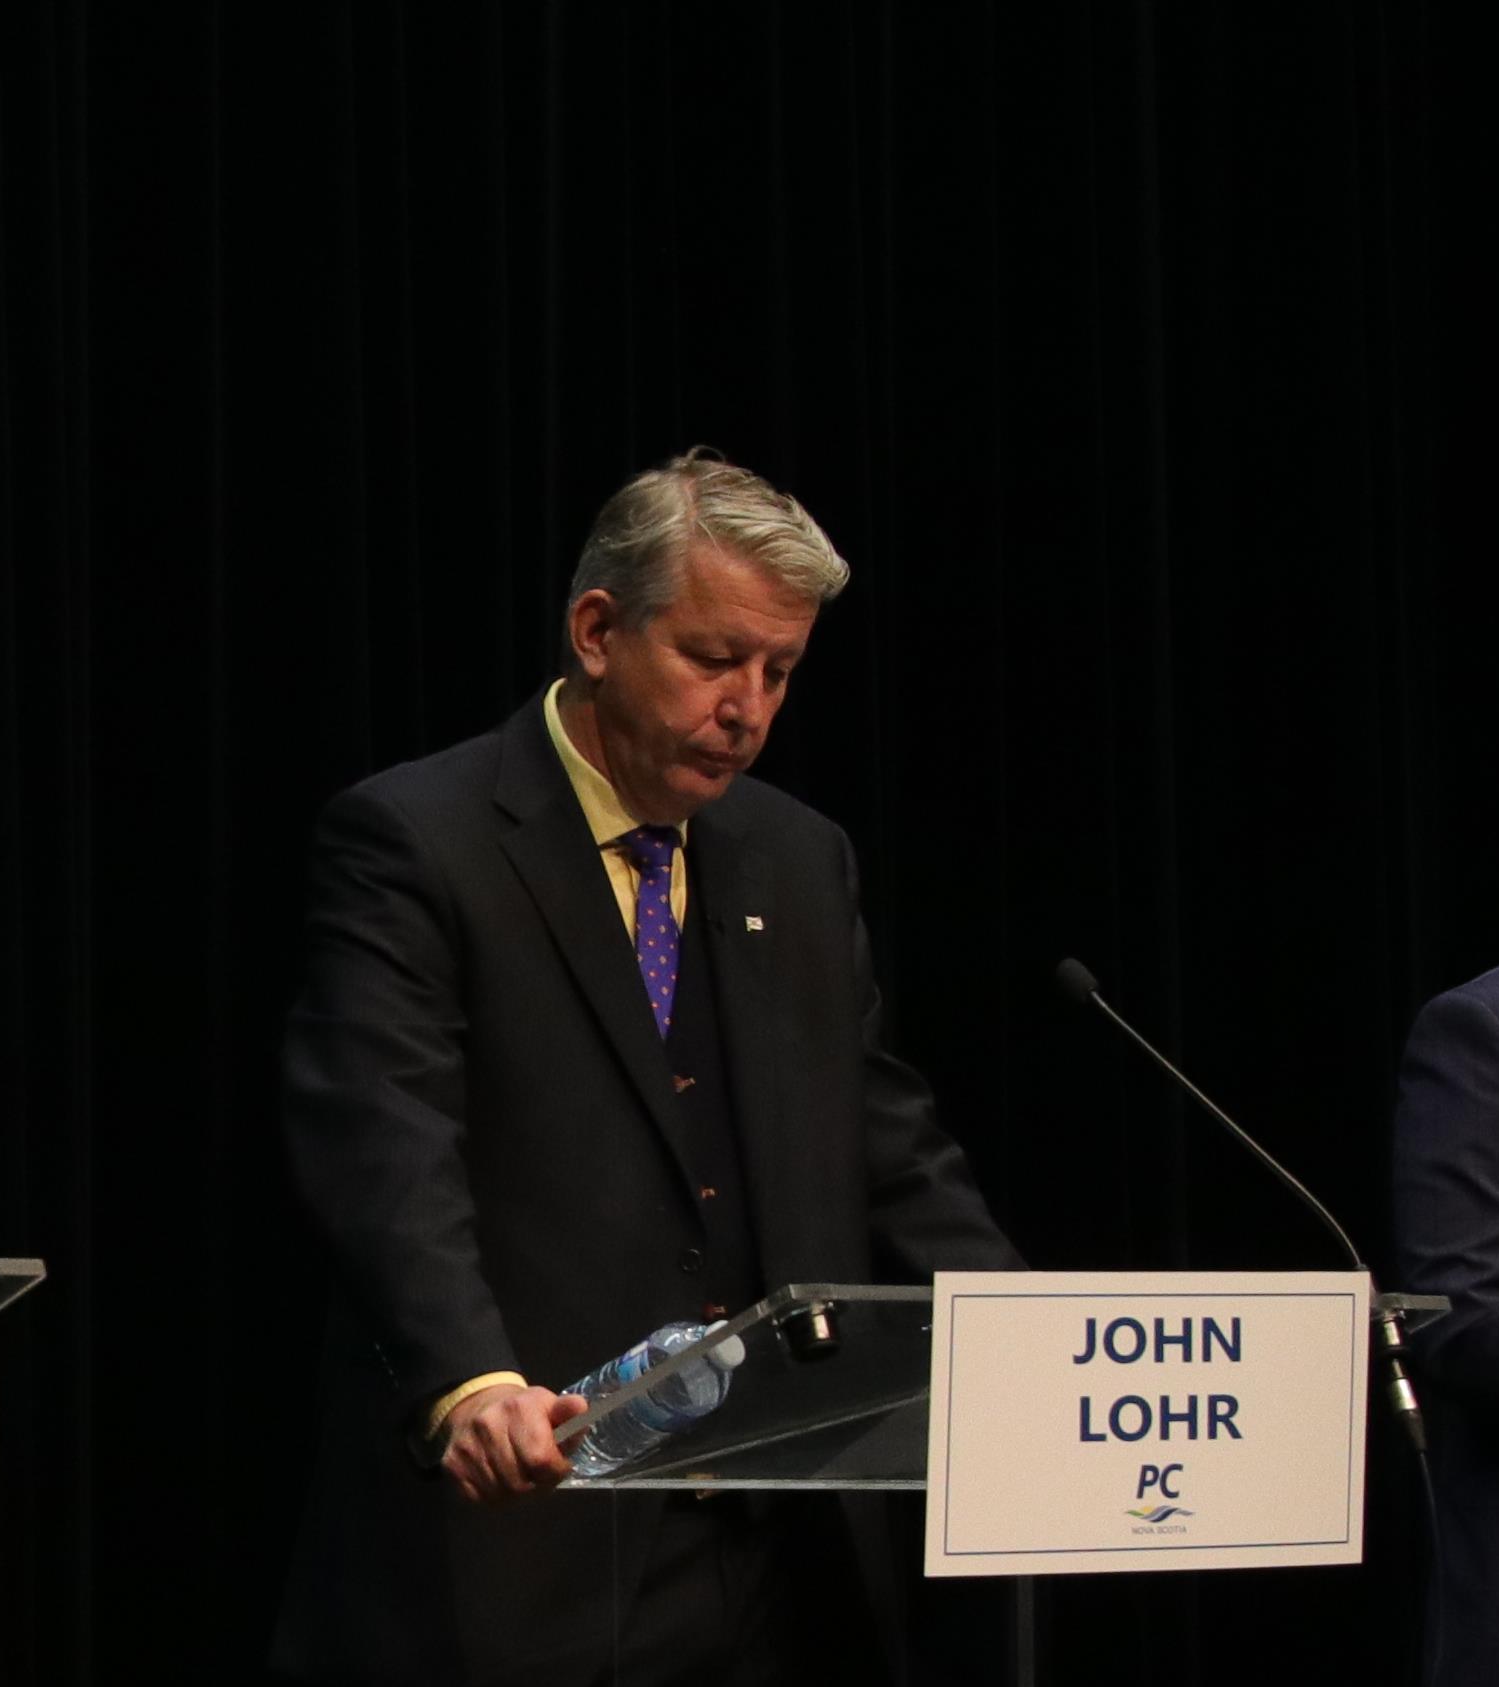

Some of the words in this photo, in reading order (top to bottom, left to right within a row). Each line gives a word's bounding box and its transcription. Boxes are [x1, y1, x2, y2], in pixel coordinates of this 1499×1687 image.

[1072, 1316, 1242, 1366] JOHN
[1078, 1394, 1243, 1443] LOHR
[1135, 1462, 1185, 1500] PC
